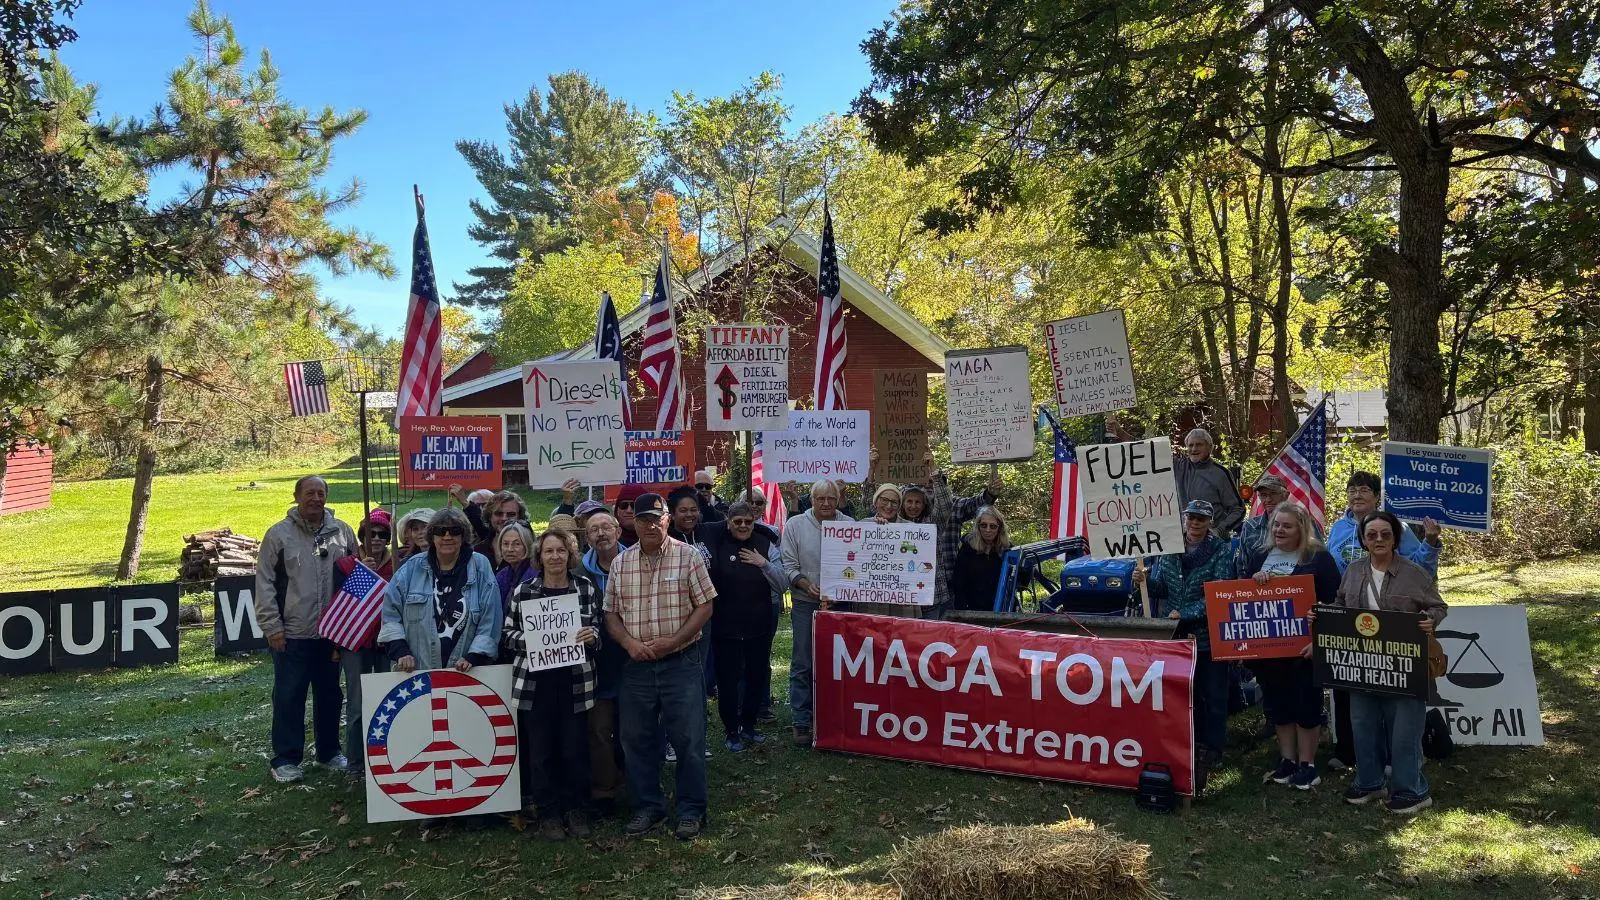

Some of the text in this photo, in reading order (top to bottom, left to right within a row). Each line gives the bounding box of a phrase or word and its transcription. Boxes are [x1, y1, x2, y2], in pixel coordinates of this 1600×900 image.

[710, 327, 784, 345] TIFFANY
[743, 366, 777, 378] DIESEL
[949, 357, 992, 377] MAGA
[1075, 363, 1091, 375] WE
[1094, 357, 1124, 371] MUST
[741, 381, 788, 391] FERTILIZER
[883, 372, 918, 387] MAGA
[740, 392, 788, 404] HAMBURGER
[884, 387, 919, 401] supports
[1109, 384, 1132, 397] WARS
[742, 405, 780, 418] COFFEE
[886, 400, 909, 412] WAR
[1063, 405, 1083, 416] SAVE
[1112, 397, 1136, 409] FARMS
[532, 410, 623, 432] No Farms
[794, 417, 856, 430] of the World
[884, 412, 921, 425] TARIFFS
[411, 425, 428, 433] Hey,
[430, 425, 448, 433] Rep.
[879, 425, 924, 439] We support
[426, 436, 478, 453] WE CAN'T
[538, 437, 615, 465] No Food
[774, 435, 856, 451] pays the toll for
[888, 439, 918, 451] FARMS
[414, 453, 490, 470] AFFORD THAT
[626, 450, 672, 467] WE CAN'T
[888, 452, 914, 464] FOOD
[1085, 440, 1171, 483] FUEL
[1405, 447, 1467, 460] Use your voice
[779, 460, 858, 475] TRUMP'S WAR
[887, 465, 926, 479] FAMILIES
[1409, 460, 1460, 476] Vote for
[1112, 480, 1142, 496] the
[1388, 475, 1484, 495] change in 2026
[1086, 492, 1174, 526] ECONOMY
[824, 526, 931, 543] maga policies make
[1122, 520, 1141, 533] not
[861, 541, 895, 554] farming
[1104, 530, 1163, 558] WAR
[871, 552, 889, 563] gas
[861, 561, 904, 572] groceries
[868, 571, 900, 583] housing
[858, 580, 910, 592] HEALTHCARE
[1215, 591, 1235, 600] Hey,
[1236, 590, 1255, 598] Rep.
[1257, 588, 1273, 596] Van
[835, 588, 918, 604] UNAFFORDABLE
[539, 598, 559, 612] WE
[1233, 599, 1288, 620] WE CAN'T
[0, 597, 172, 660] OUR
[525, 610, 575, 632] SUPPORT
[1224, 617, 1304, 641] AFFORD THAT
[541, 631, 568, 646] OUR
[1317, 633, 1421, 658] DERRICK VAN ORDEN
[529, 644, 585, 668] FARMERS!
[1325, 648, 1413, 673] HAZARDOUS TO
[832, 633, 1165, 712] MAGA TOM
[1331, 664, 1408, 688] YOUR HEALTH
[1444, 707, 1526, 737] For All
[853, 701, 1143, 768] Too Extreme
